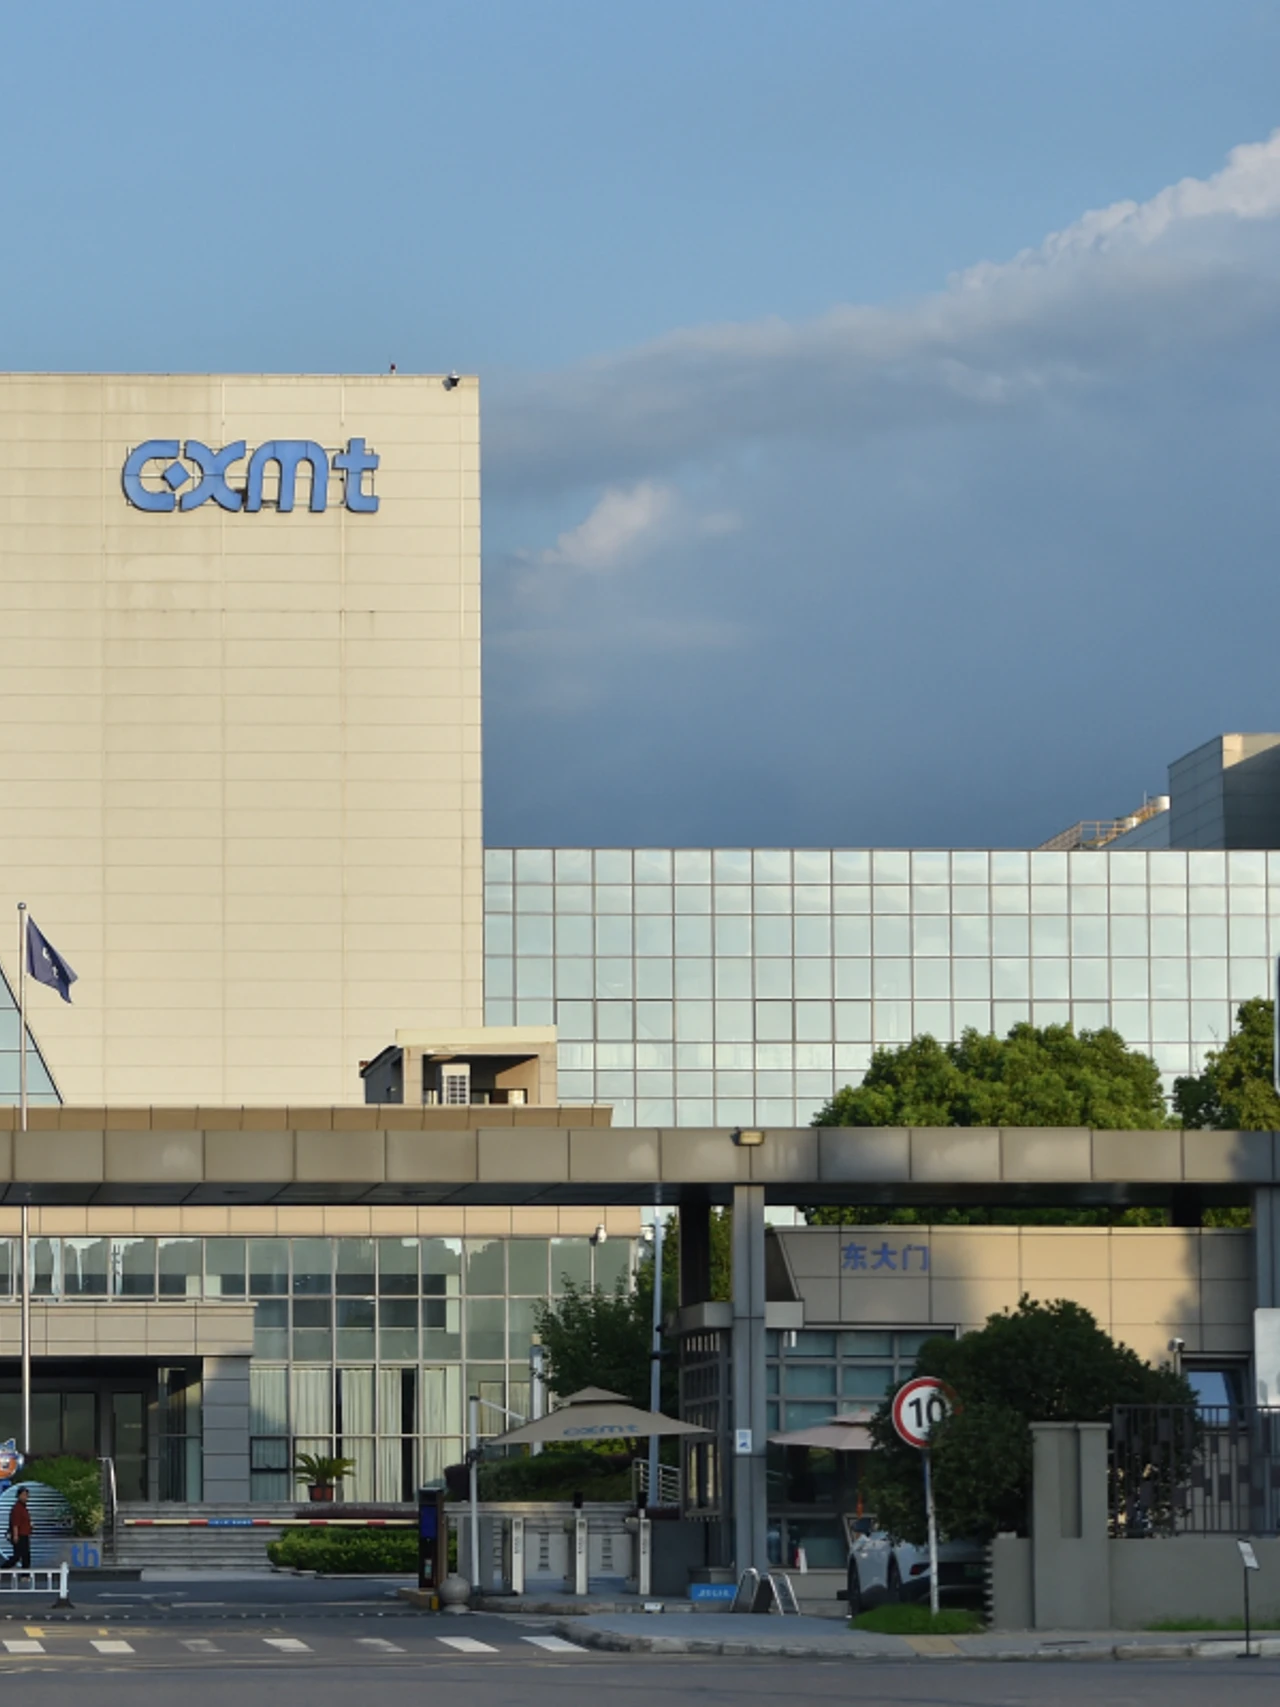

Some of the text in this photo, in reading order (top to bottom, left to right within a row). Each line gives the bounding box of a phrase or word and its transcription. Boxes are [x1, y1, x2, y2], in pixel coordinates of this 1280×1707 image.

[121, 437, 380, 513] cxmt
[841, 1241, 929, 1271] 东大门
[908, 1396, 947, 1428] 10
